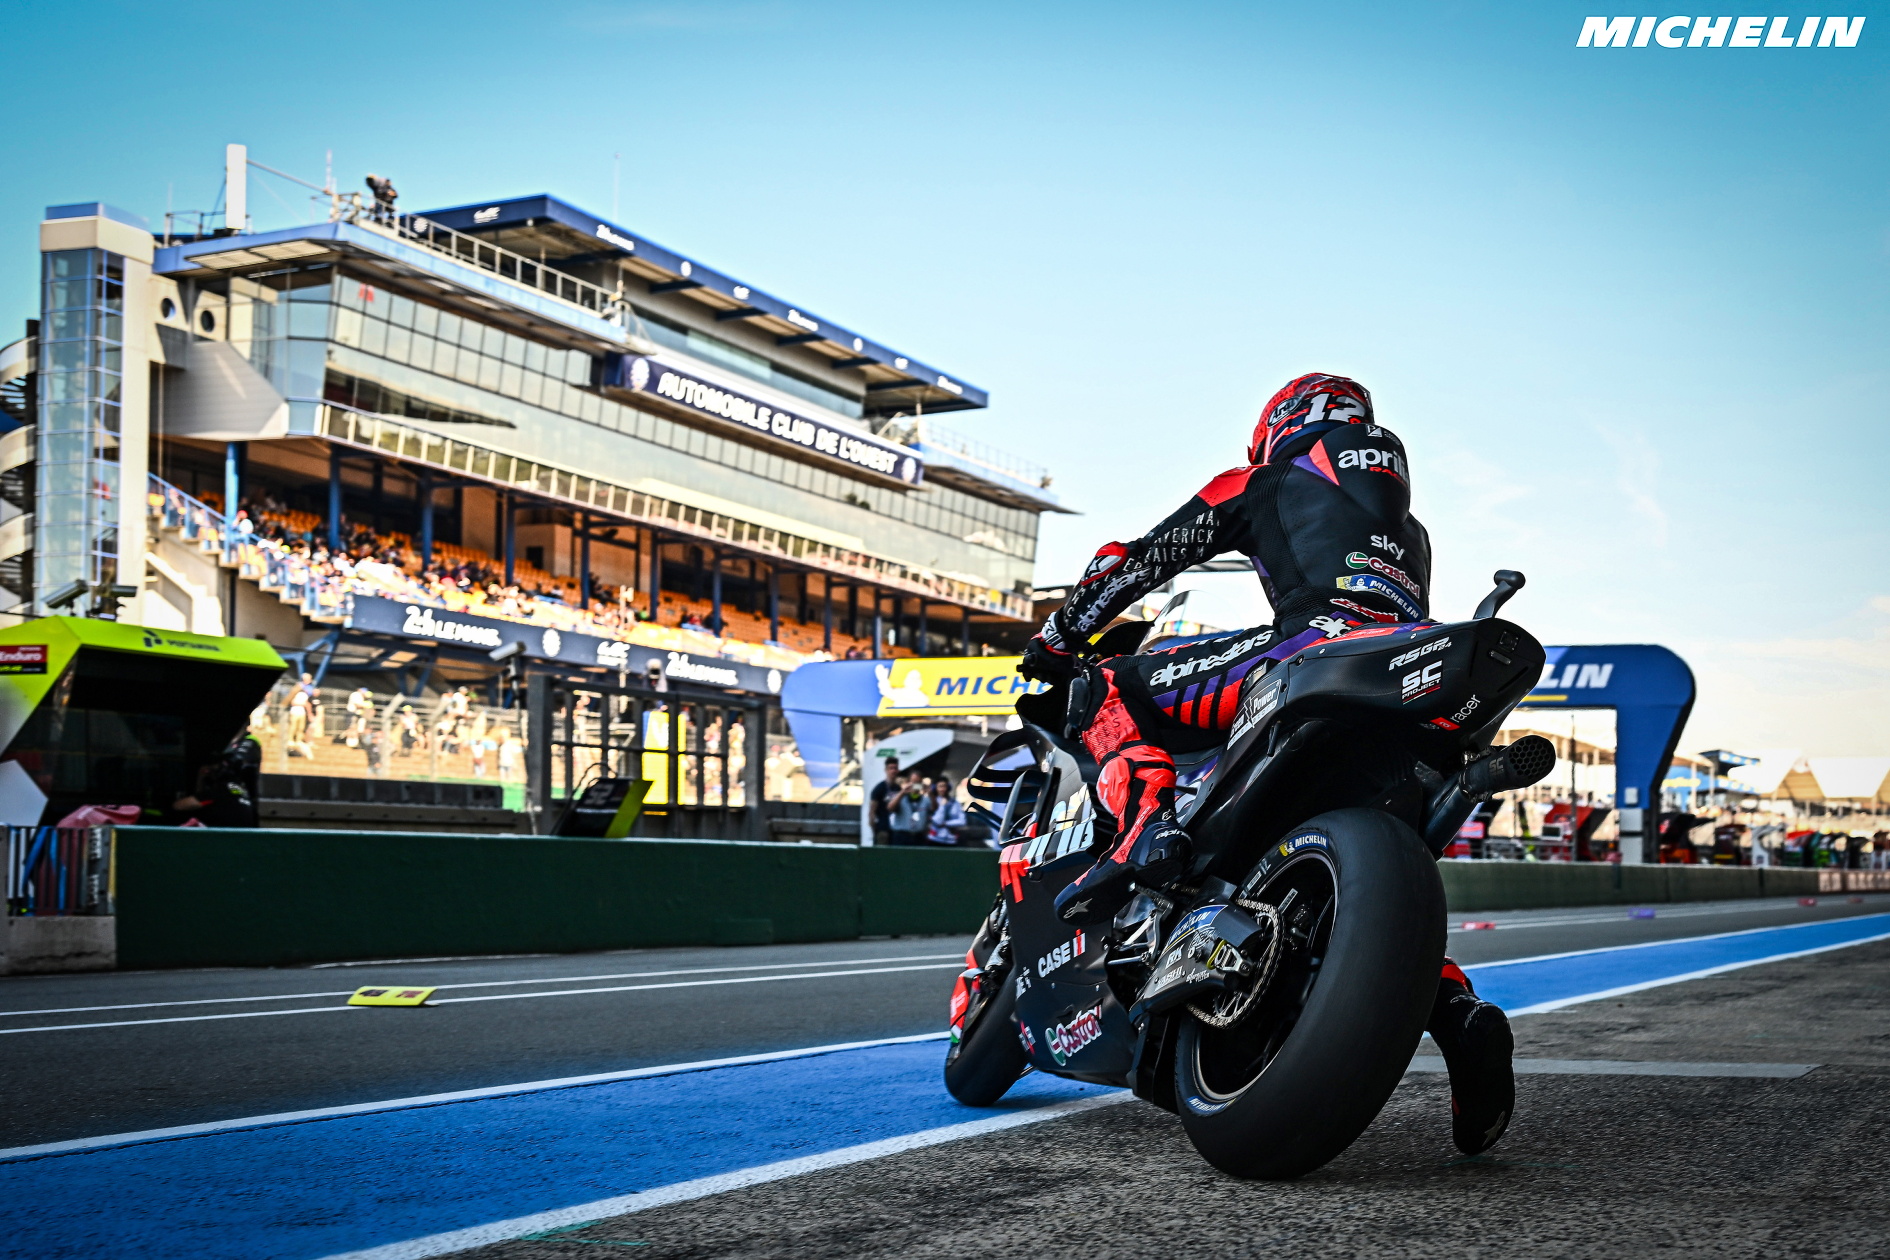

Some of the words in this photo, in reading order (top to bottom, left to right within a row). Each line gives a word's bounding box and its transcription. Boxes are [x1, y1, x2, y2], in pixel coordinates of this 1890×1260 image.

[657, 372, 772, 431] AUTOMOBILE
[771, 412, 815, 446] CLUB
[815, 428, 840, 455] DE
[838, 437, 898, 475] L'OUEST
[1370, 534, 1405, 561] sky
[1368, 556, 1421, 599] Castrol
[1370, 580, 1419, 619] MICHELIN
[1149, 630, 1275, 687] alpinestars
[1402, 660, 1443, 694] SC
[1402, 678, 1442, 700] PROJECT
[1450, 694, 1481, 723] racer
[1294, 834, 1327, 848] MICHELIN
[1037, 941, 1071, 978] CASE
